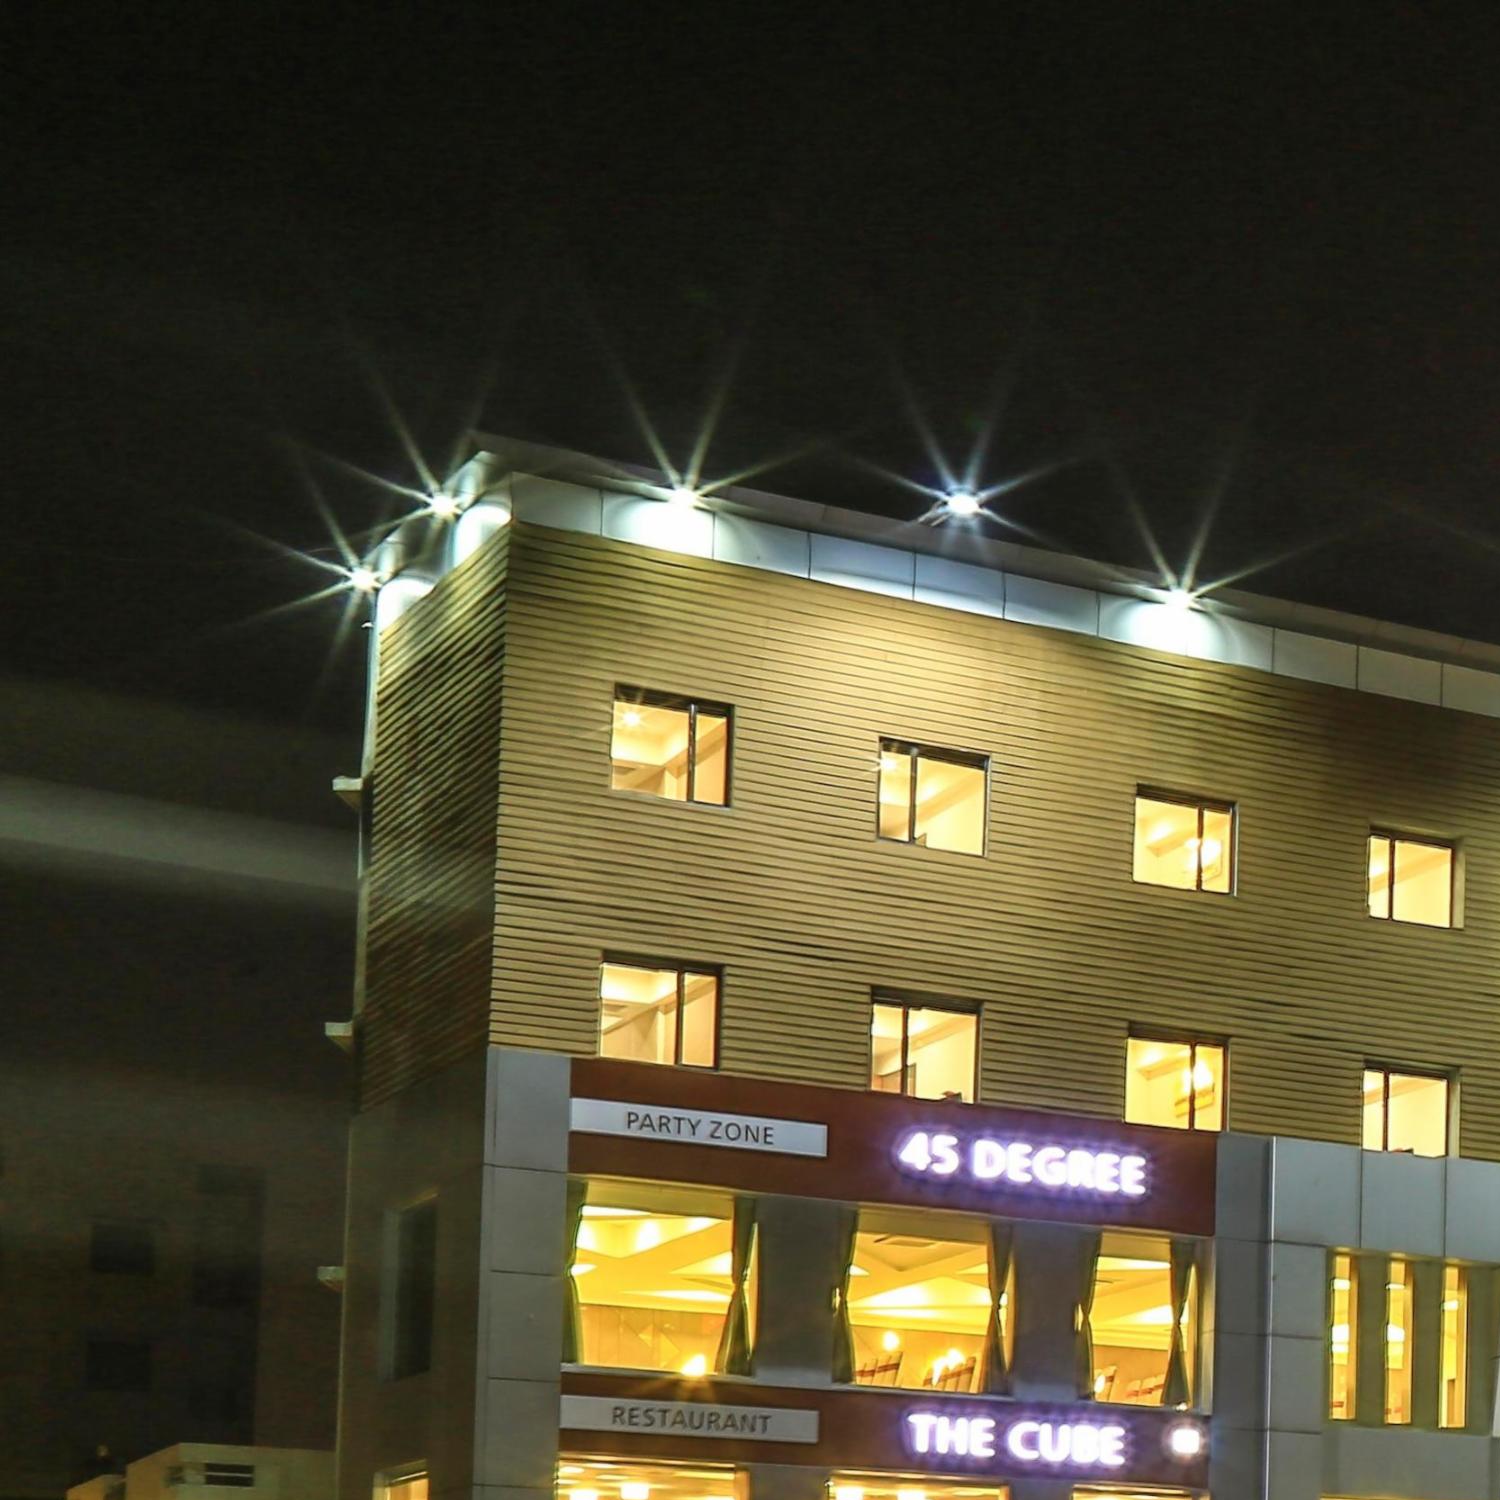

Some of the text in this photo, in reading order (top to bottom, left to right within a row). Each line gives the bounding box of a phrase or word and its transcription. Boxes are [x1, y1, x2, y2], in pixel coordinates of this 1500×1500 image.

[626, 1111, 775, 1145] PARTY ZONE
[898, 1131, 1147, 1195] 45 DEGREE
[611, 1405, 773, 1434] RESTAURANT
[908, 1412, 1125, 1466] THE CUBE
